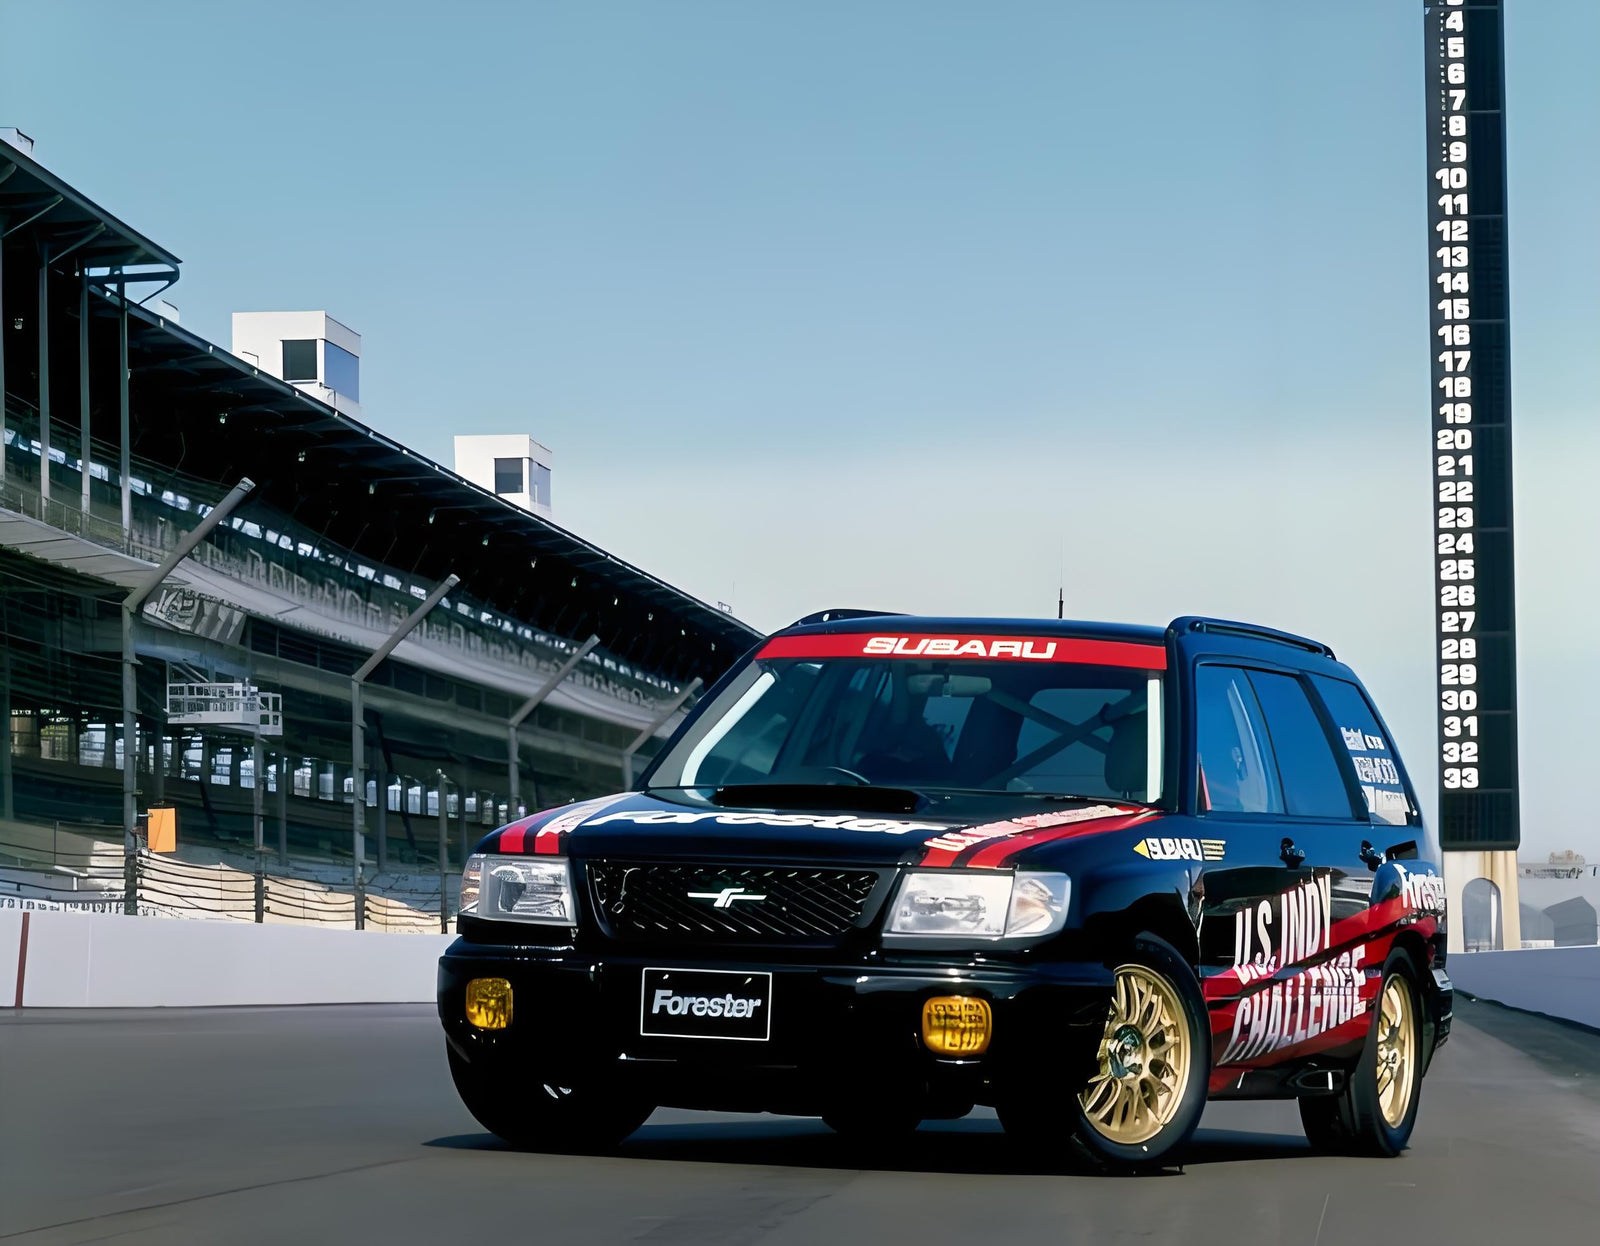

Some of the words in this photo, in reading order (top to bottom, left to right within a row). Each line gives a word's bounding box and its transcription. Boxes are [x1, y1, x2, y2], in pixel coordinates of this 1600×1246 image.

[1445, 10, 1464, 33] 4
[1447, 36, 1465, 59] 5
[1447, 62, 1466, 85] 6
[1448, 89, 1466, 111] 7
[1448, 115, 1467, 137] 8
[1449, 141, 1467, 163] 9
[1435, 167, 1468, 190] 10
[1437, 193, 1468, 216] 11
[1435, 219, 1469, 242] 12
[1436, 246, 1469, 268] 13
[1436, 272, 1469, 294] 14
[1437, 298, 1470, 320] 15
[1437, 324, 1471, 346] 16
[1438, 350, 1471, 372] 17
[1438, 376, 1472, 398] 18
[1439, 402, 1472, 424] 19
[1436, 428, 1473, 450] 20
[1437, 454, 1473, 477] 21
[1438, 480, 1474, 503] 22
[1438, 506, 1474, 529] 23
[1438, 532, 1474, 555] 24
[1440, 559, 1475, 581] 25
[1440, 584, 1476, 607] 26
[1441, 611, 1476, 633] 27
[863, 637, 1057, 659] SUBARU
[1441, 637, 1477, 660] 28
[1441, 663, 1477, 686] 29
[1441, 689, 1478, 711] 30
[1443, 715, 1478, 737] 31
[1442, 741, 1479, 763] 32
[1443, 767, 1479, 789] 33
[1280, 873, 1331, 968] INDY
[651, 989, 762, 1018] Forester
[1216, 945, 1366, 1066] CHALLENGE
